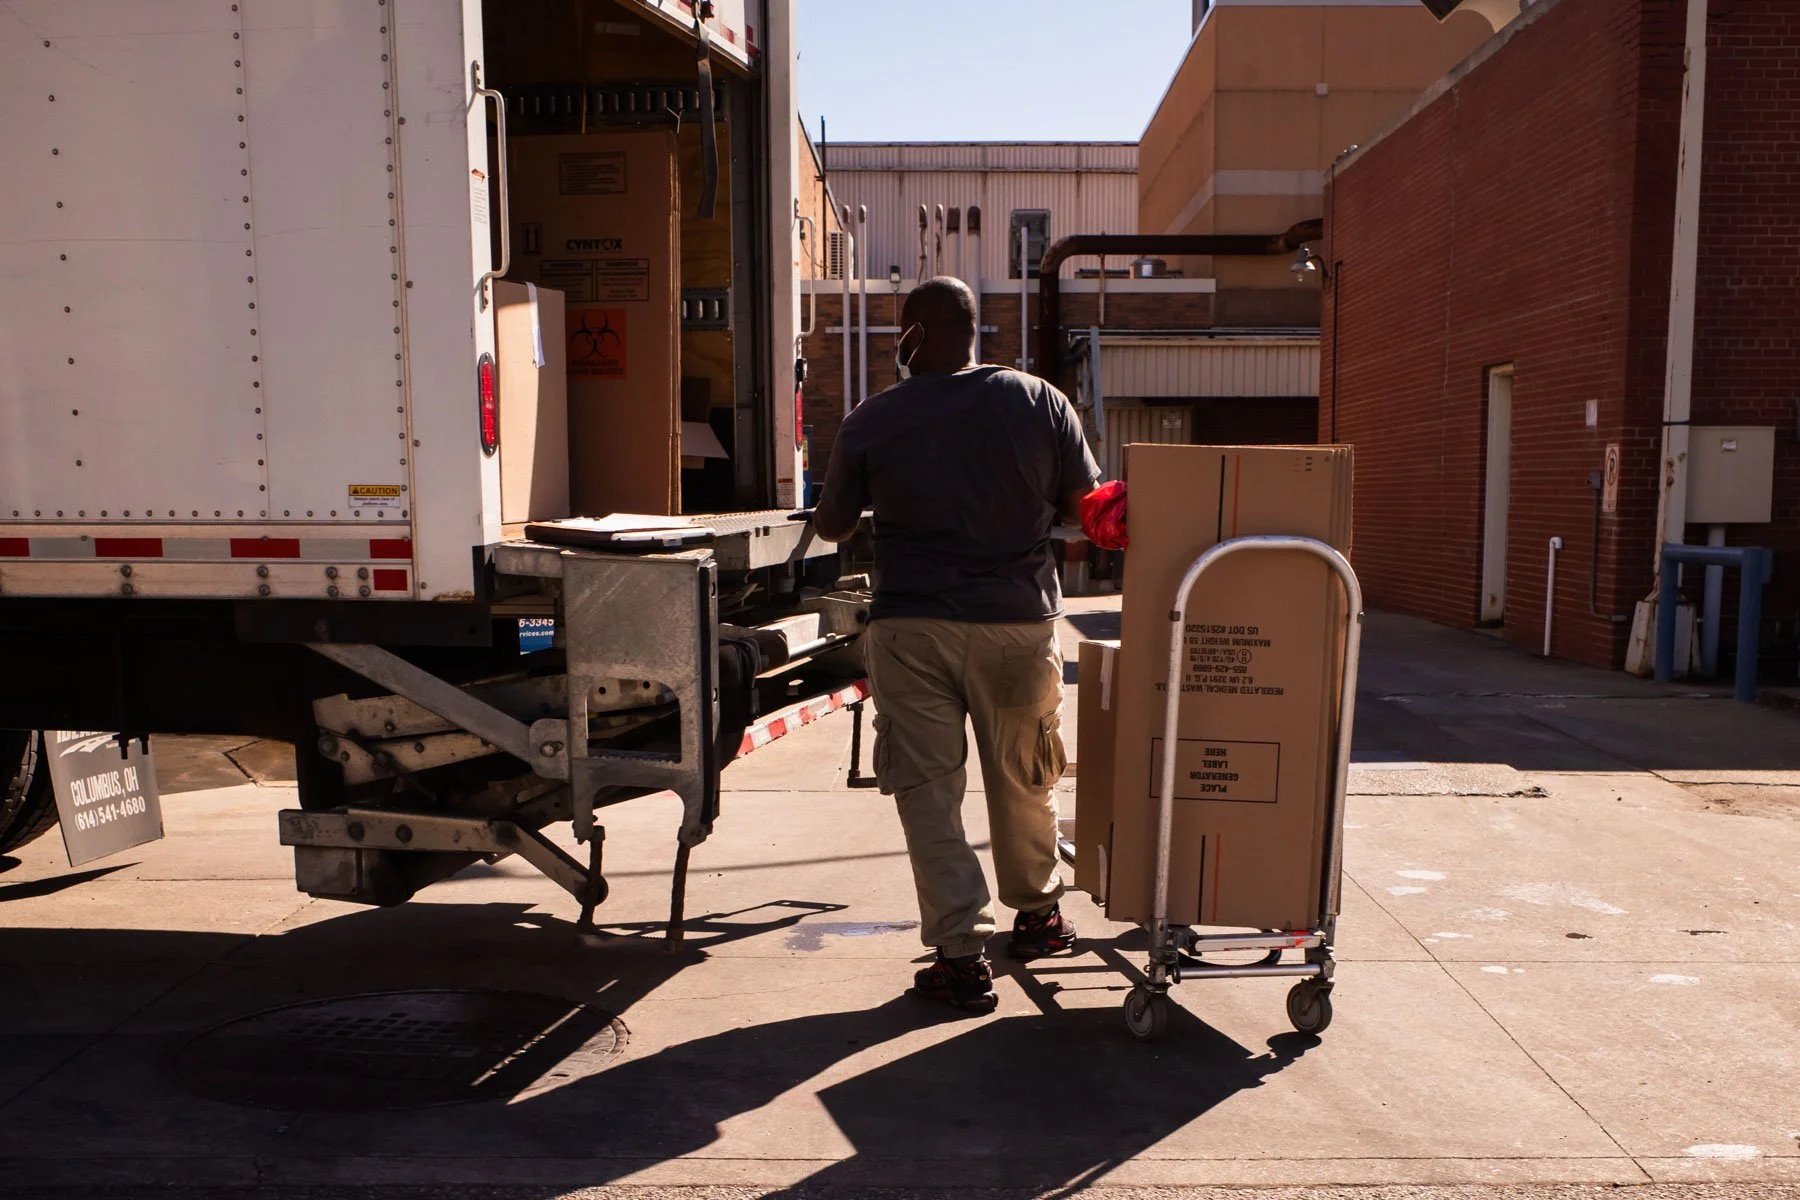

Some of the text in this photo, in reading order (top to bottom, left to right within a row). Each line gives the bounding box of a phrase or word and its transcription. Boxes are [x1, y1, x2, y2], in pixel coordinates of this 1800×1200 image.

[565, 238, 623, 251] CYNTOX
[519, 618, 554, 628] 6-3345
[1185, 624, 1259, 635] US DOT #2515320
[1190, 636, 1199, 645] 55
[1201, 637, 1231, 646] WEIGHT
[1232, 638, 1271, 648] MAXIMUM
[1211, 675, 1227, 683] 3291
[1229, 676, 1240, 684] UN
[1242, 676, 1254, 684] 6.2
[1180, 683, 1201, 693] WAST
[1206, 684, 1240, 694] MEDICAL
[1241, 686, 1284, 696] REGULATED
[1204, 747, 1227, 757] HERE
[1202, 759, 1228, 769] LABEL
[1189, 771, 1239, 781] GENERATOR
[70, 765, 139, 807] COLUMBUS, OH
[1200, 783, 1227, 793] PLACE
